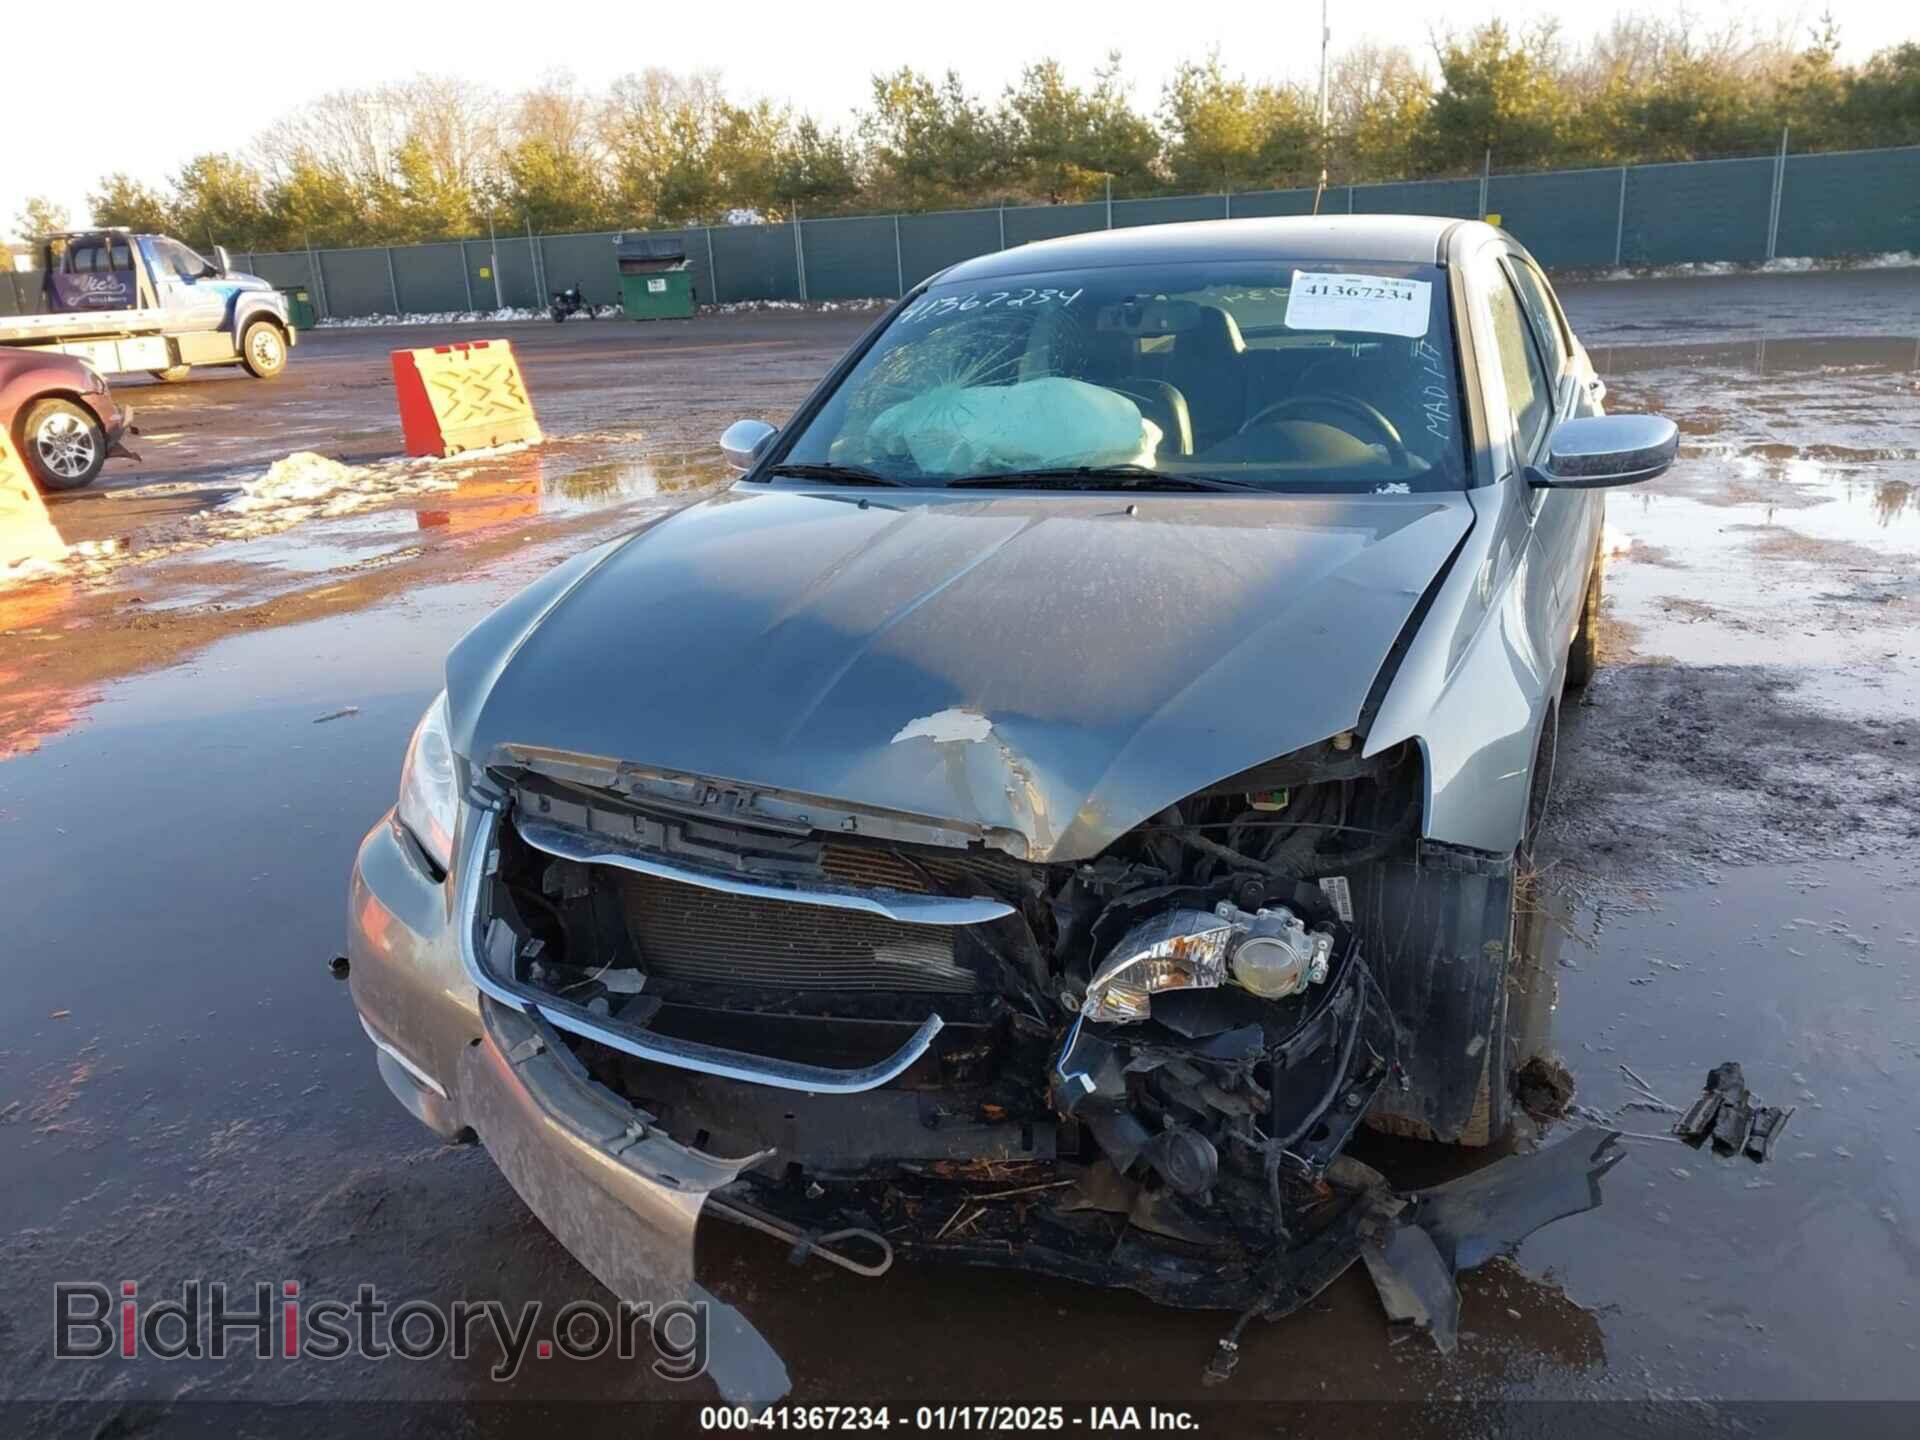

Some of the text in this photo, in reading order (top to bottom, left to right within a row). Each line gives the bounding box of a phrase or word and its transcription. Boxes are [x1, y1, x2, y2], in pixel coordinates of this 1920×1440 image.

[899, 288, 1084, 324] 41367234
[1305, 284, 1412, 301] 41367234
[1423, 385, 1452, 440] MAD
